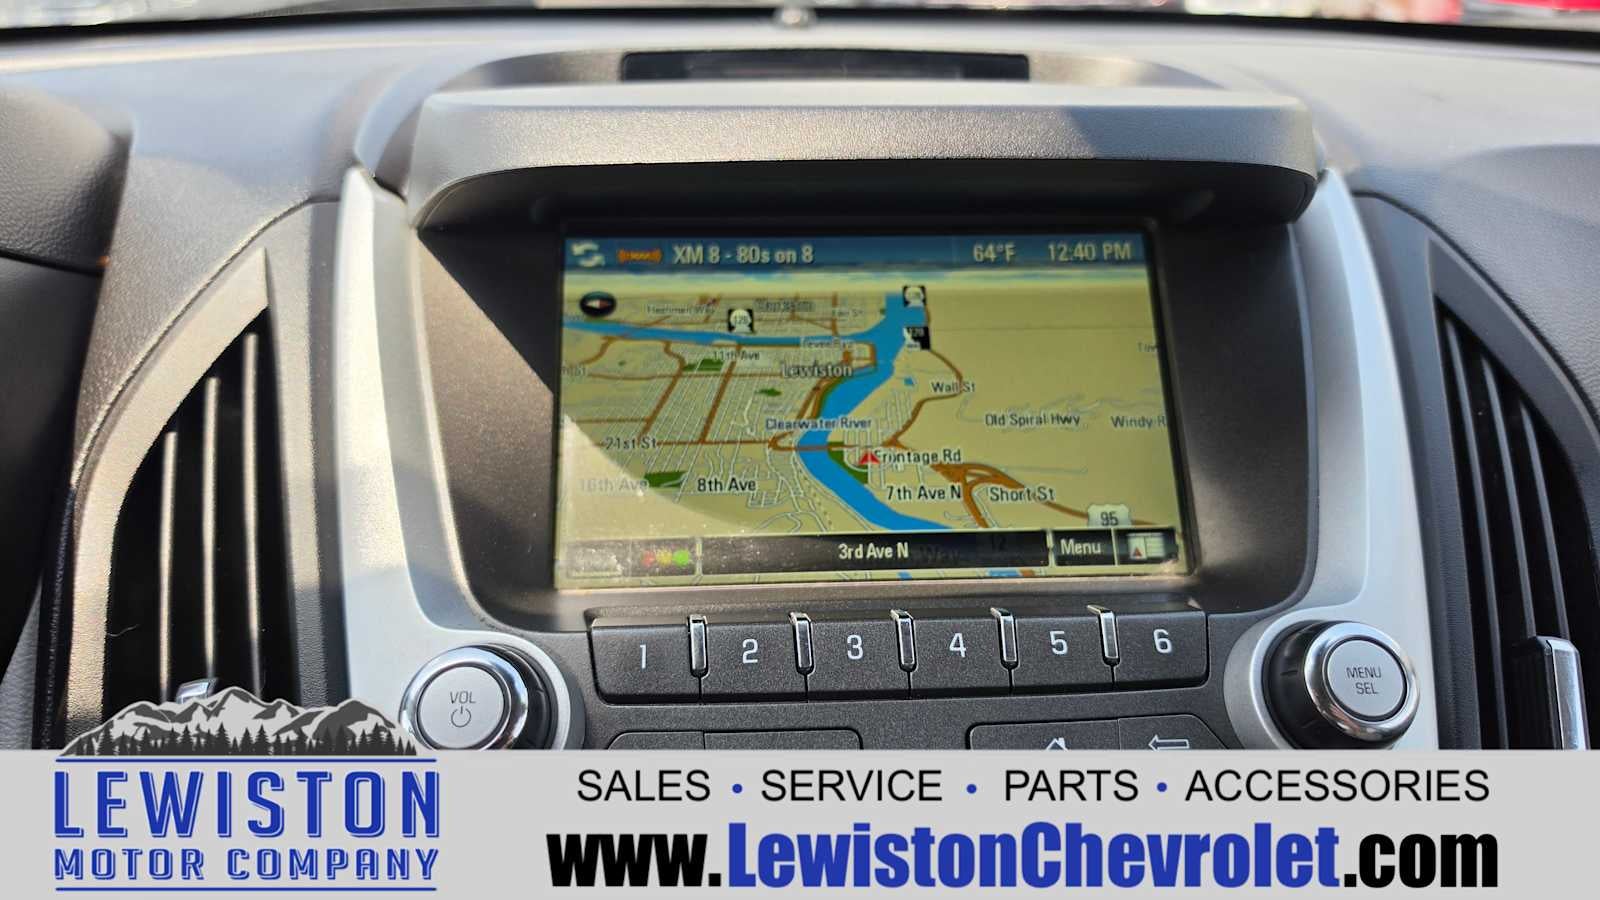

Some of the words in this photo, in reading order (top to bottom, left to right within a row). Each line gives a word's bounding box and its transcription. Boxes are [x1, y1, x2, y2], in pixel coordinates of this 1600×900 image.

[673, 247, 704, 264] XM
[709, 246, 720, 263] 8
[737, 245, 770, 263] 80s
[775, 249, 796, 263] on
[801, 245, 813, 263] 8
[973, 243, 1016, 261] 64°F
[1049, 243, 1096, 260] 12:40
[1103, 242, 1131, 260] PM
[740, 351, 760, 360] Ave
[781, 361, 852, 378] Lewiston
[932, 381, 958, 393] Wall
[765, 417, 838, 430] Clearwater
[839, 417, 872, 430] River
[985, 412, 1007, 426] Old
[1010, 412, 1046, 430] Spiral
[1051, 413, 1080, 428] Hwy
[1111, 415, 1152, 429] Windy
[605, 437, 636, 450] 21st
[640, 437, 656, 449] St
[875, 450, 938, 466] Frontage
[943, 449, 961, 463] Rd
[619, 477, 648, 491] Ave
[697, 478, 724, 492] 8th
[728, 477, 756, 492] Ave
[886, 486, 912, 500] 7th
[917, 486, 947, 500] Ave
[951, 486, 961, 499] N
[990, 486, 1032, 501] Short
[1037, 486, 1055, 501] St
[1100, 511, 1119, 526] 95
[838, 543, 864, 560] 3rd
[866, 543, 893, 558] Ave
[897, 542, 909, 558] N
[1060, 539, 1102, 555] Menu
[847, 634, 864, 661] 3
[948, 632, 967, 658] 4
[1051, 630, 1068, 655] 5
[1154, 628, 1172, 654] 6
[640, 644, 647, 669] 1
[742, 639, 758, 664] 2
[1346, 666, 1381, 679] MENU
[1355, 682, 1378, 695] SEL
[450, 691, 476, 704] VOL
